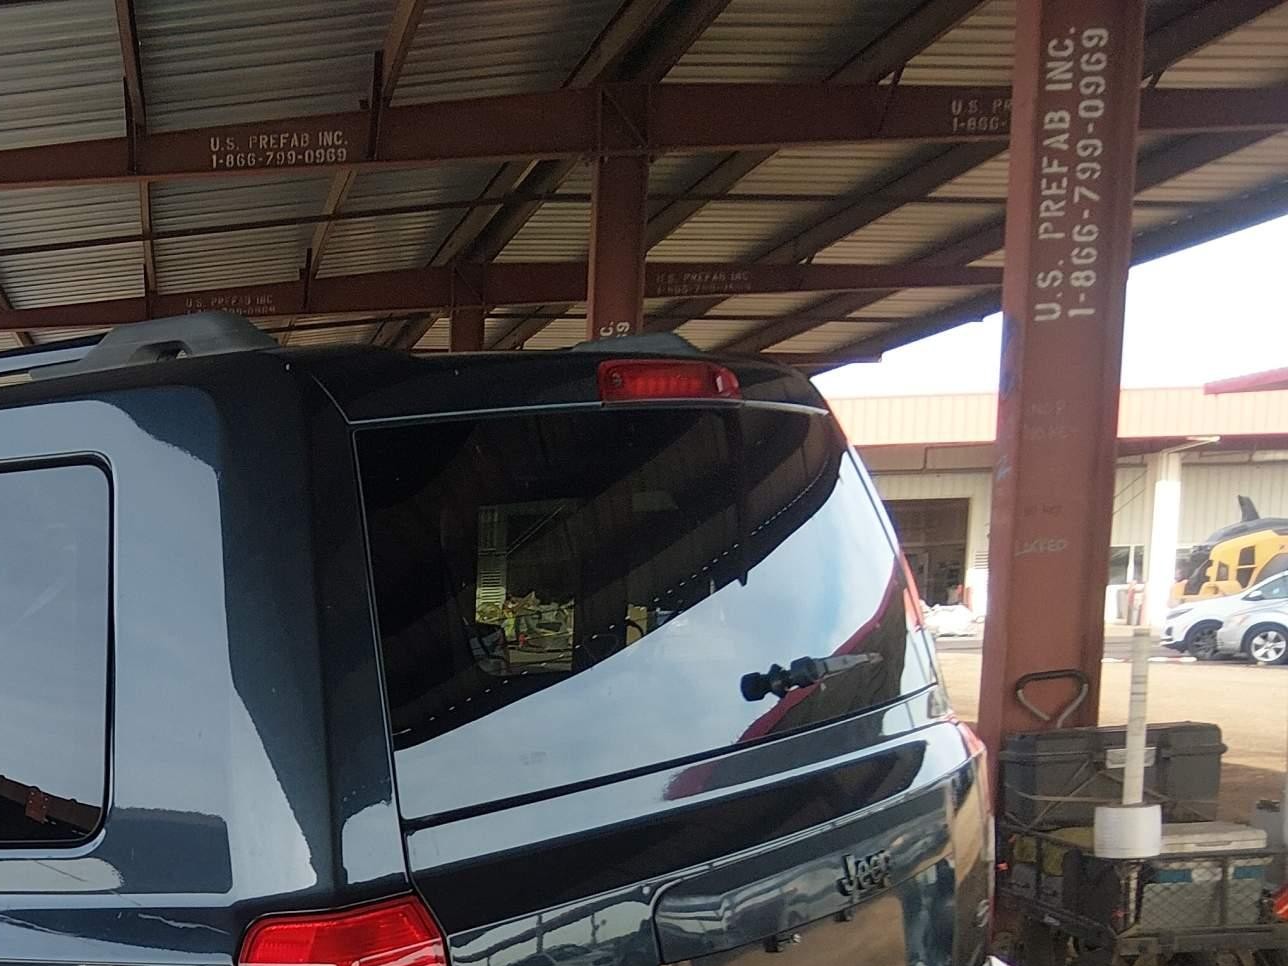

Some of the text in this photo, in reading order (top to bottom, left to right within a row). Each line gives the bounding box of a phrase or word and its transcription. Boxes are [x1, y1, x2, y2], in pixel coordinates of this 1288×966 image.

[210, 130, 349, 152] U.S. PREFAB INC.
[211, 148, 348, 169] 1-866-799-0969
[1033, 26, 1076, 321] U.S. PREFAB INC.
[1067, 26, 1109, 318] 1-866-799-0969
